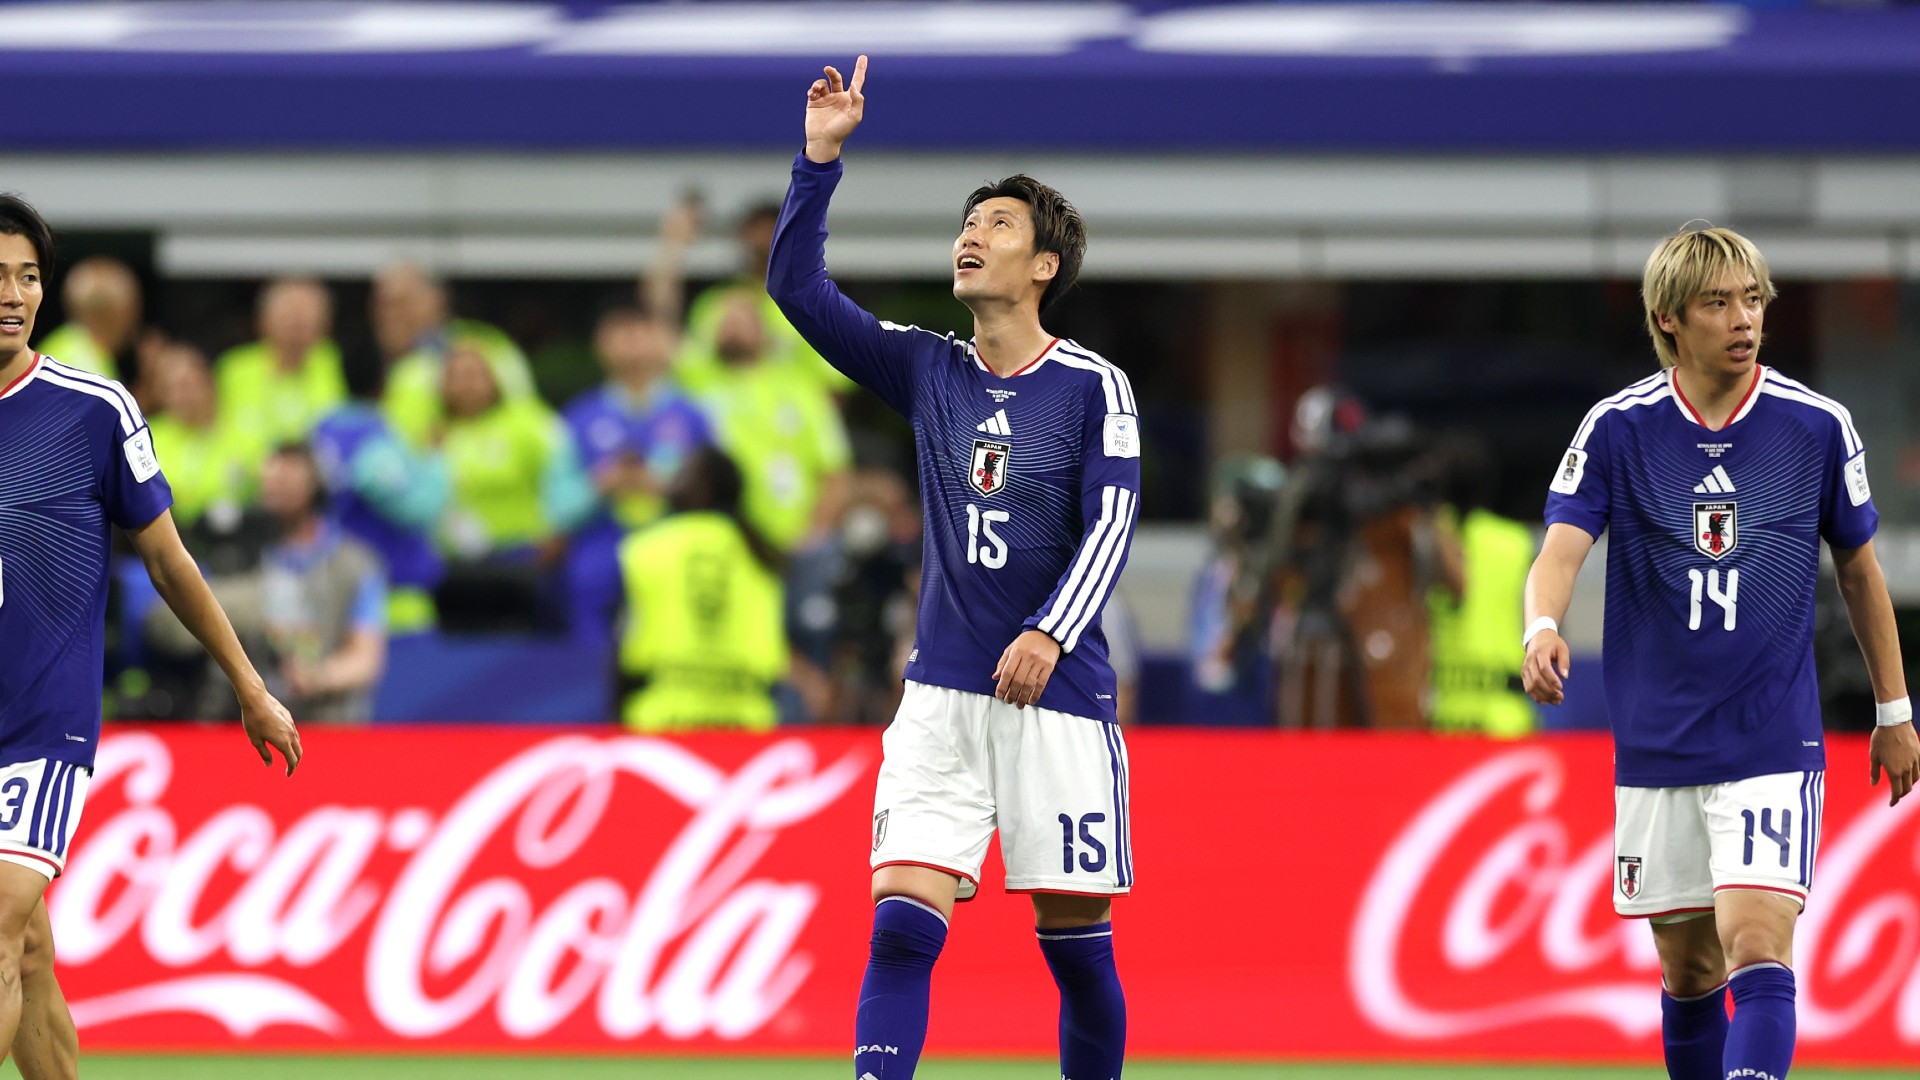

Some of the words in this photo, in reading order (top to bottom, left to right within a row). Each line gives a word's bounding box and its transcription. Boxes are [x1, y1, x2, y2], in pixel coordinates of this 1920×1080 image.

[966, 503, 1010, 570] 15
[1688, 568, 1739, 632] 14
[1058, 812, 1106, 874] 15
[1741, 807, 1791, 868] 14
